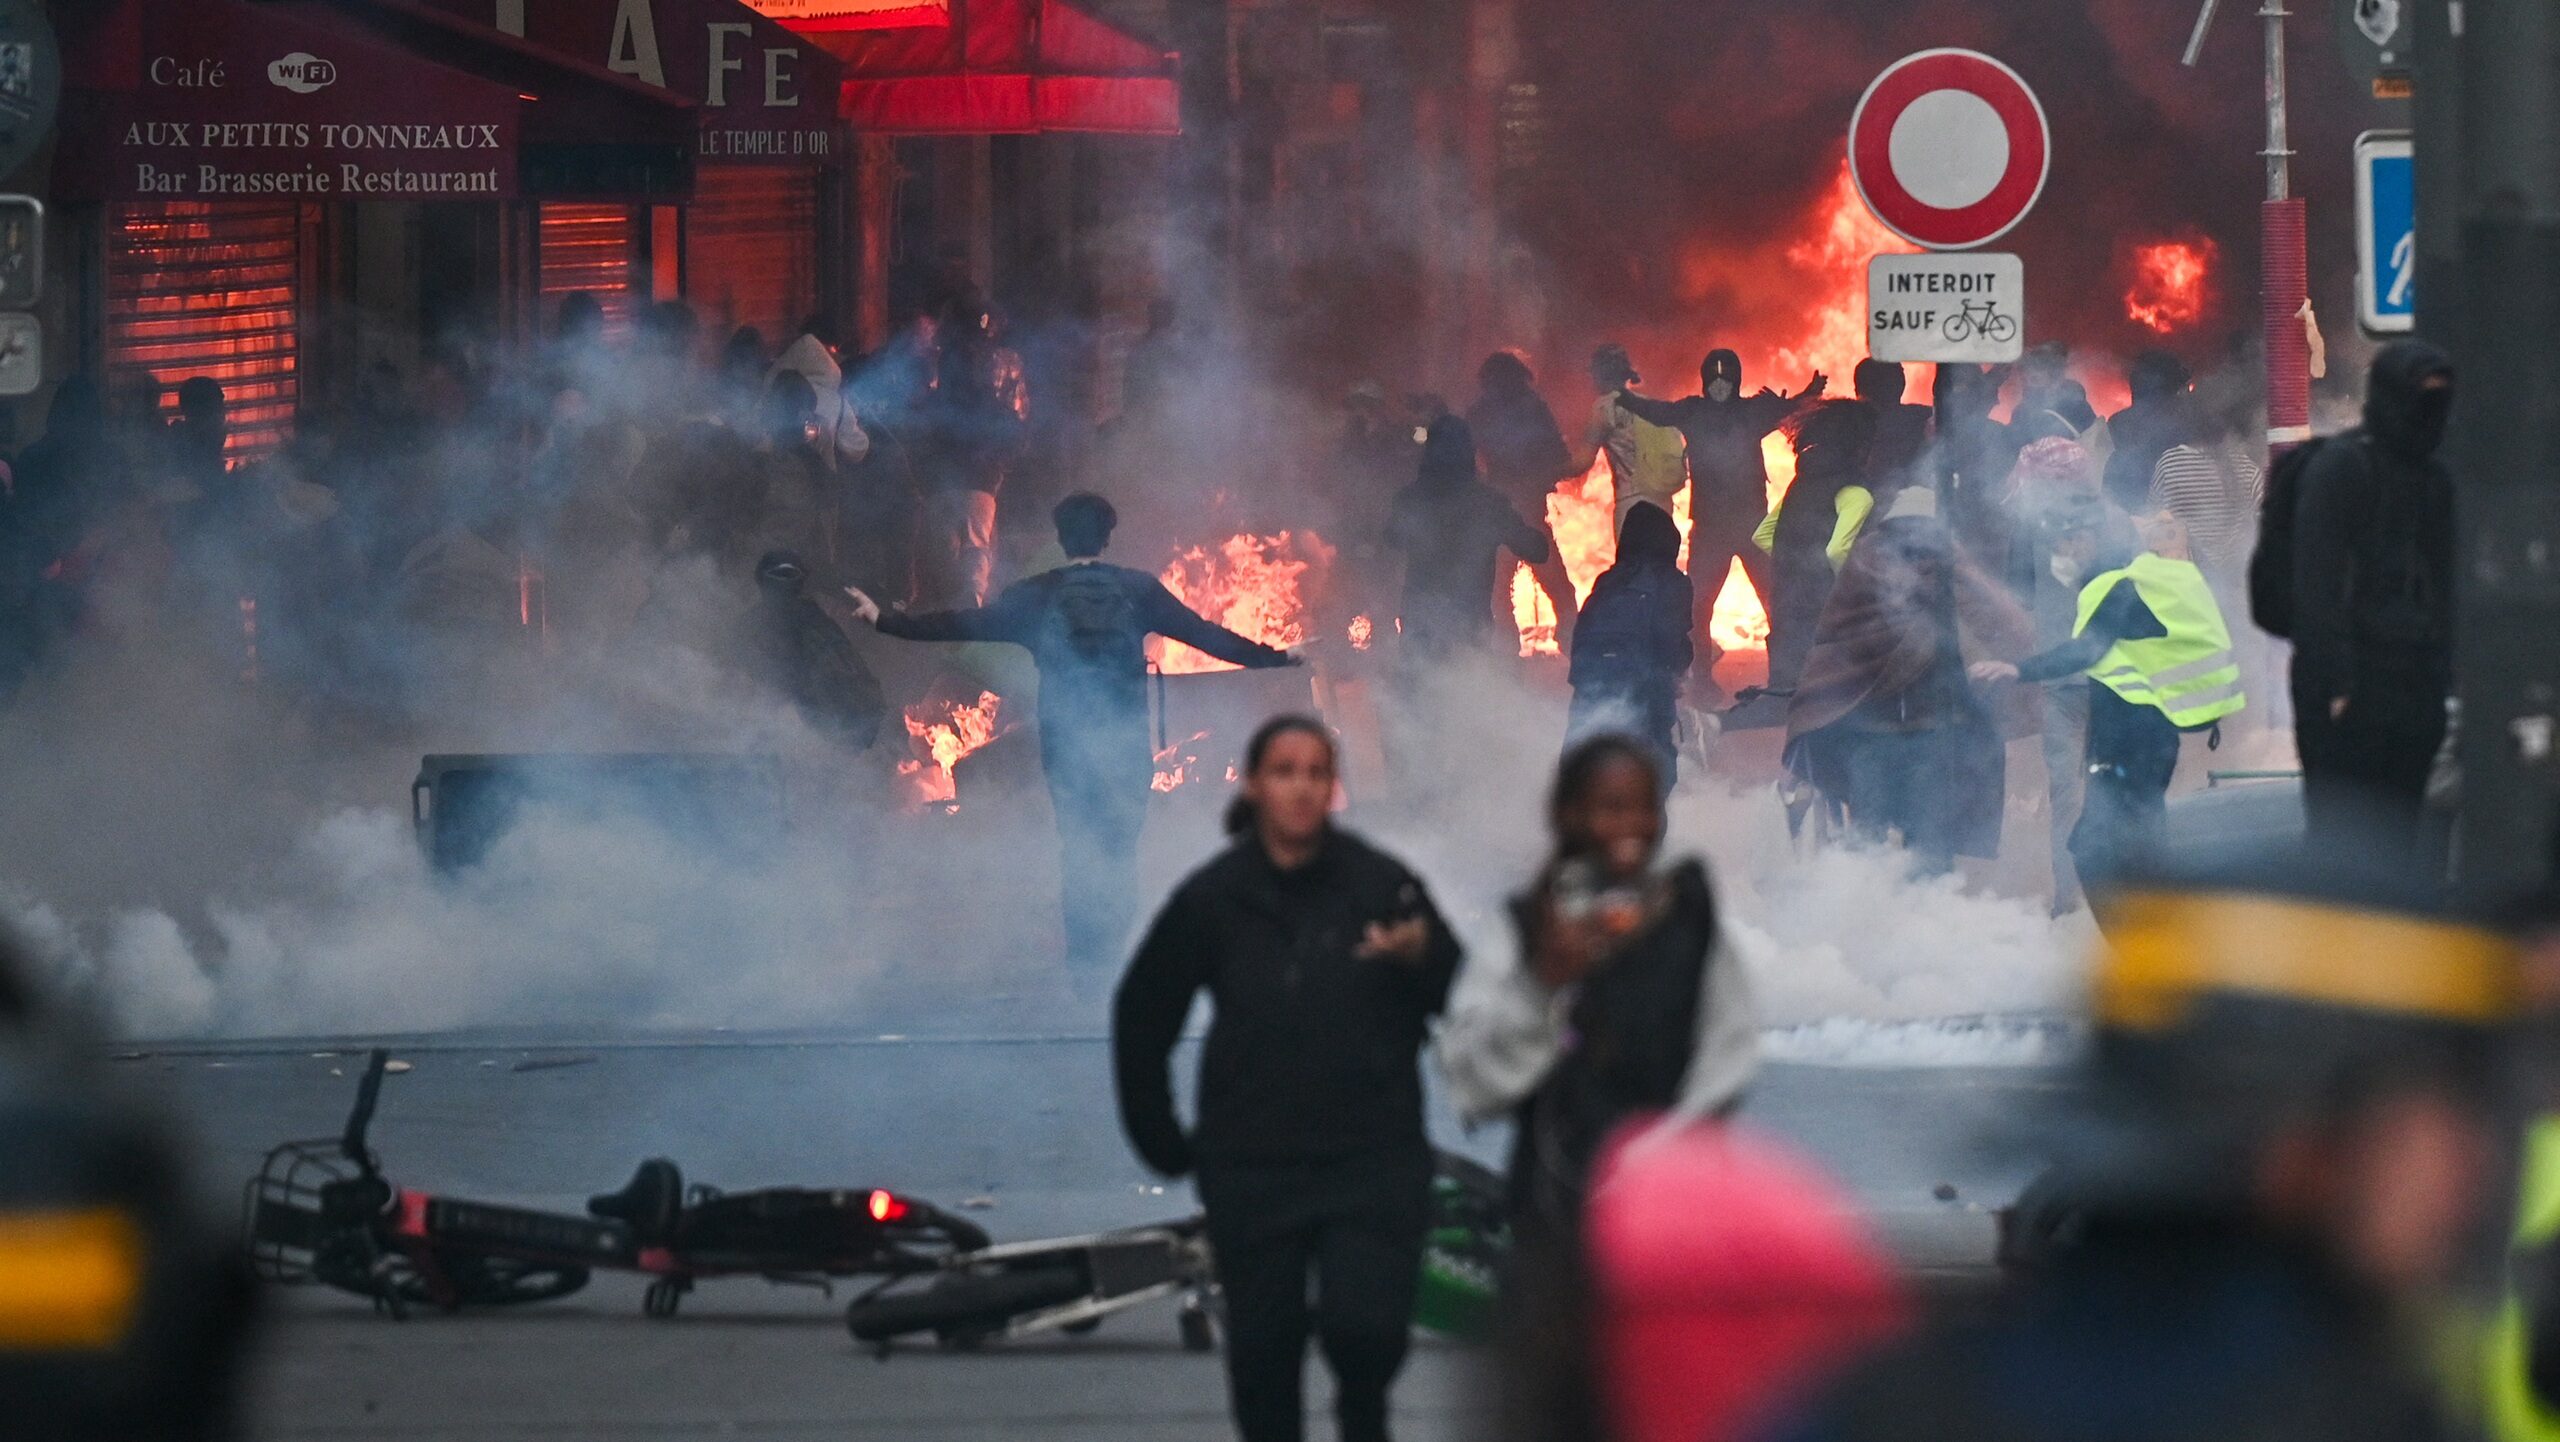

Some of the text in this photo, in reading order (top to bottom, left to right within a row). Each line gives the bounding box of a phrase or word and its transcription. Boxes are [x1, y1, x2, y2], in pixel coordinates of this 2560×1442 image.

[151, 57, 225, 88] Café
[123, 122, 499, 149] AUX PETITS TONNEAUX
[700, 130, 829, 155] LE TEMPLE D'OR
[137, 163, 499, 193] Bar Brasserie Restaurant
[1889, 273, 1996, 293] INTERDIT
[1874, 310, 1936, 330] SAUF
